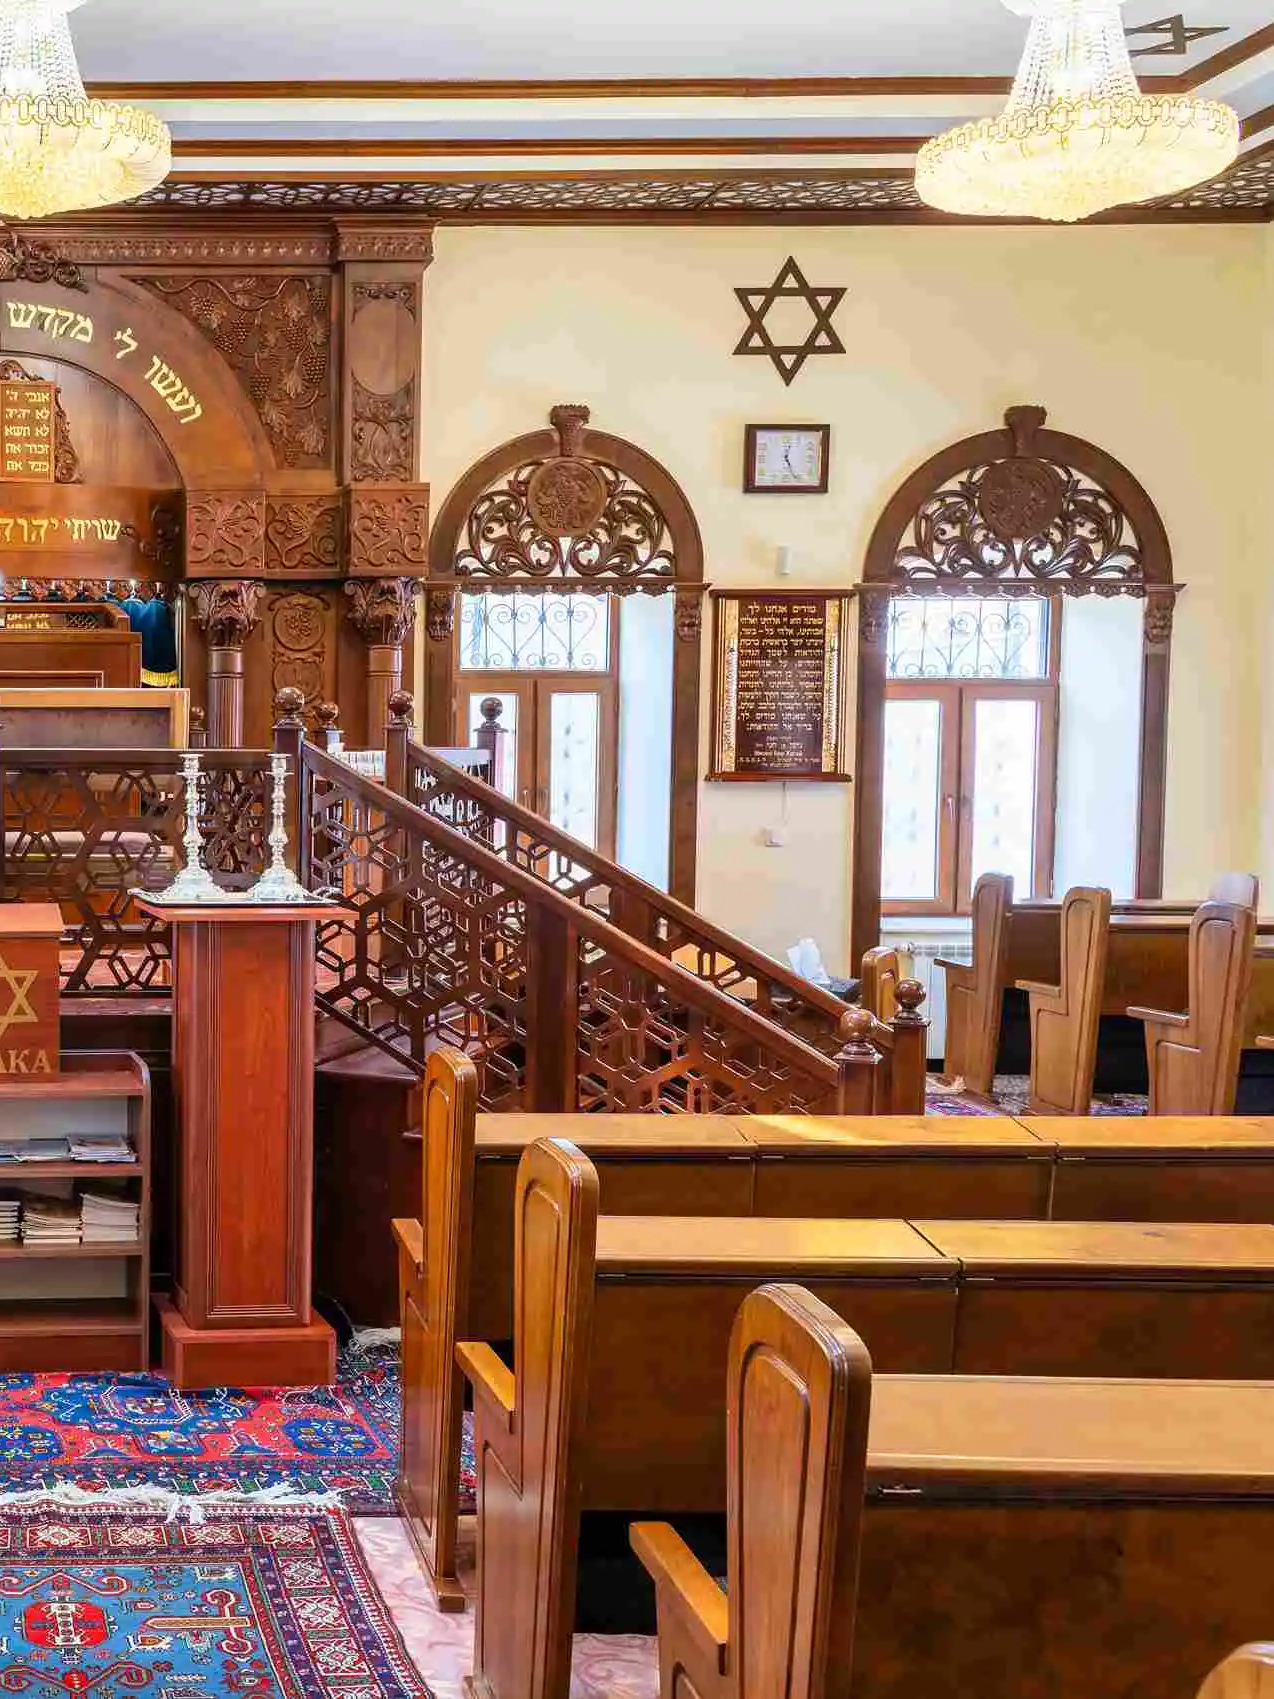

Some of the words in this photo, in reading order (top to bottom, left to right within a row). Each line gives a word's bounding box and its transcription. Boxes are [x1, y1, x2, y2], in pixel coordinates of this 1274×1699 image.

[6, 301, 94, 343] מקדש
[113, 327, 138, 359] לי
[144, 355, 203, 424] ועשו
[63, 517, 122, 542] שויתי
